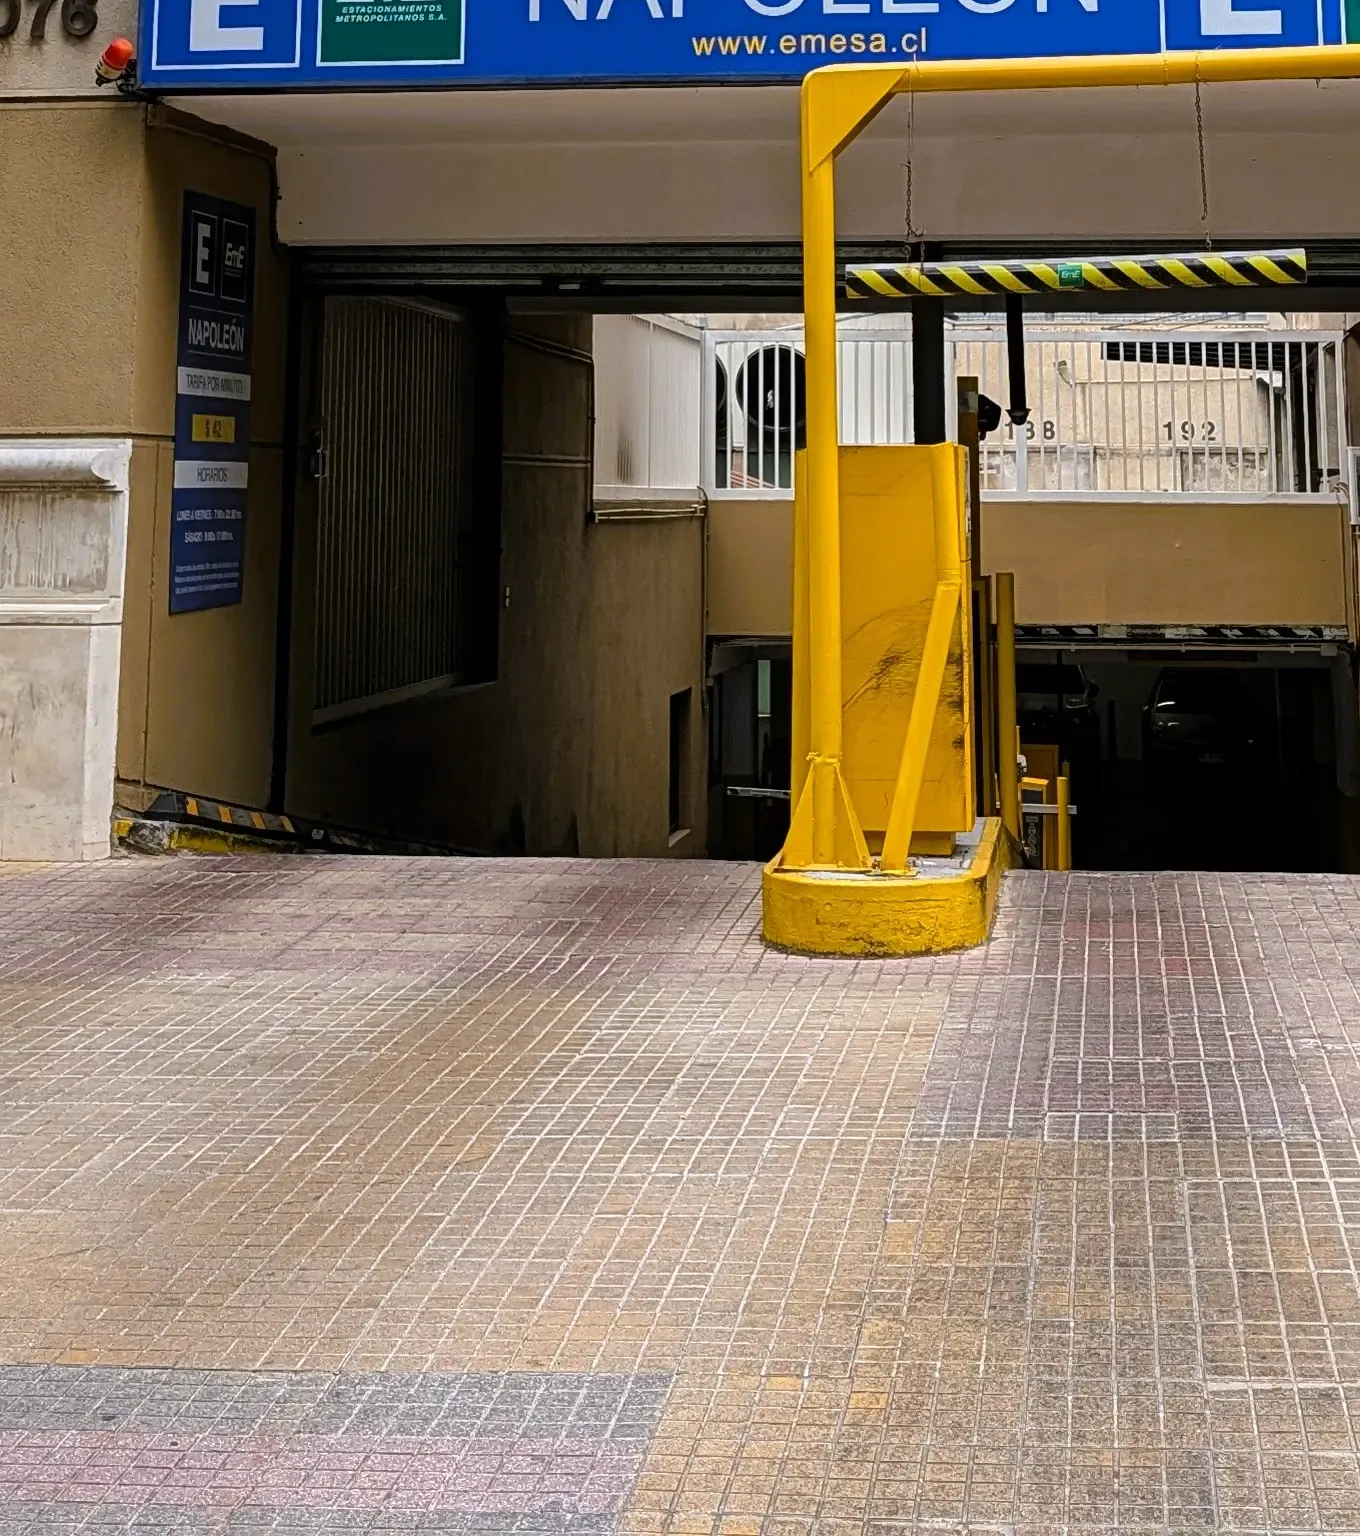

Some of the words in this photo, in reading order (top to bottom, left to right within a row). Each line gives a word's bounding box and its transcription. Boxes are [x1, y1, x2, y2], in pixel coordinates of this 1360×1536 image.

[334, 13, 425, 23] METROPOLITANOS
[428, 13, 447, 21] S.A.
[341, 4, 442, 14] ESTACIONAMIENTOS
[691, 26, 927, 57] www.emesa.cl
[195, 221, 211, 284] E
[188, 317, 244, 352] NAPOLEÓN
[1163, 421, 1216, 442] 192
[196, 467, 228, 483] HORARIOS
